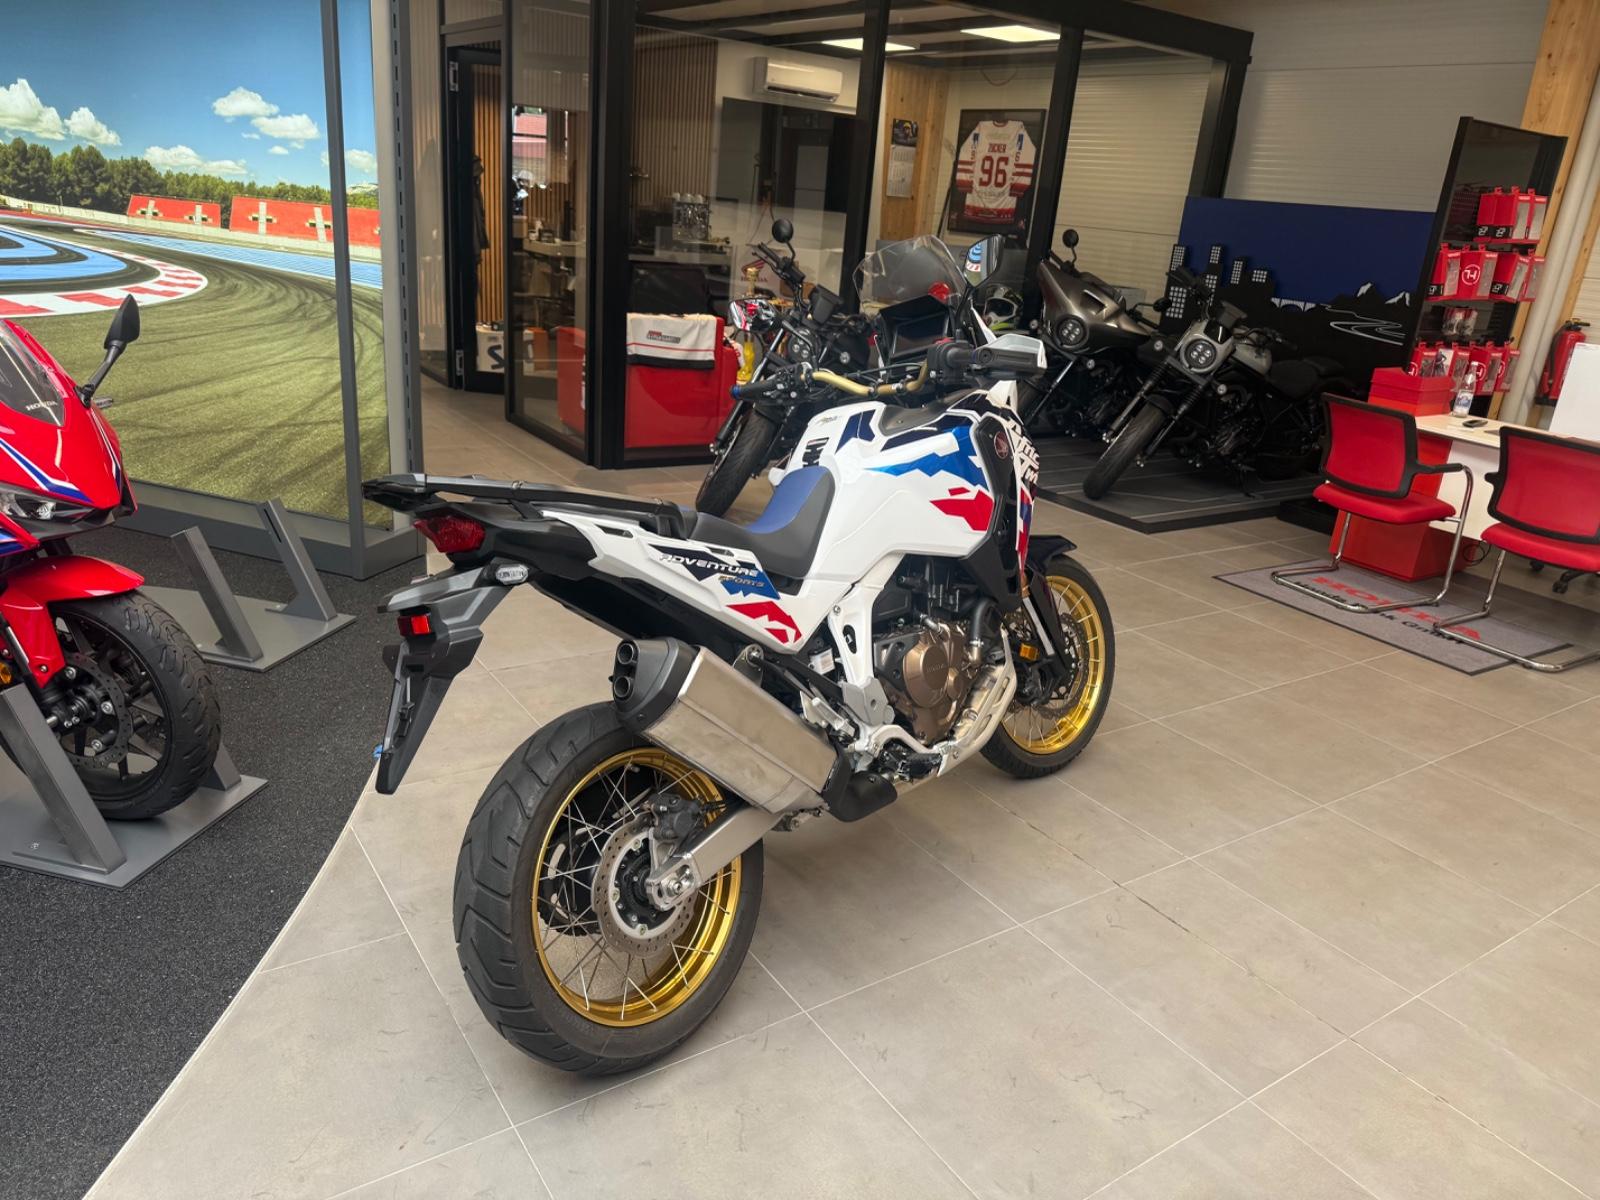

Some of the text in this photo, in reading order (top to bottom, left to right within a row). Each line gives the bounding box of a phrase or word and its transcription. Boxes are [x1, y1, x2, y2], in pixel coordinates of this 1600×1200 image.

[979, 156, 1009, 188] 96
[660, 552, 761, 577] ADVENTURE
[717, 574, 766, 588] SPORTS
